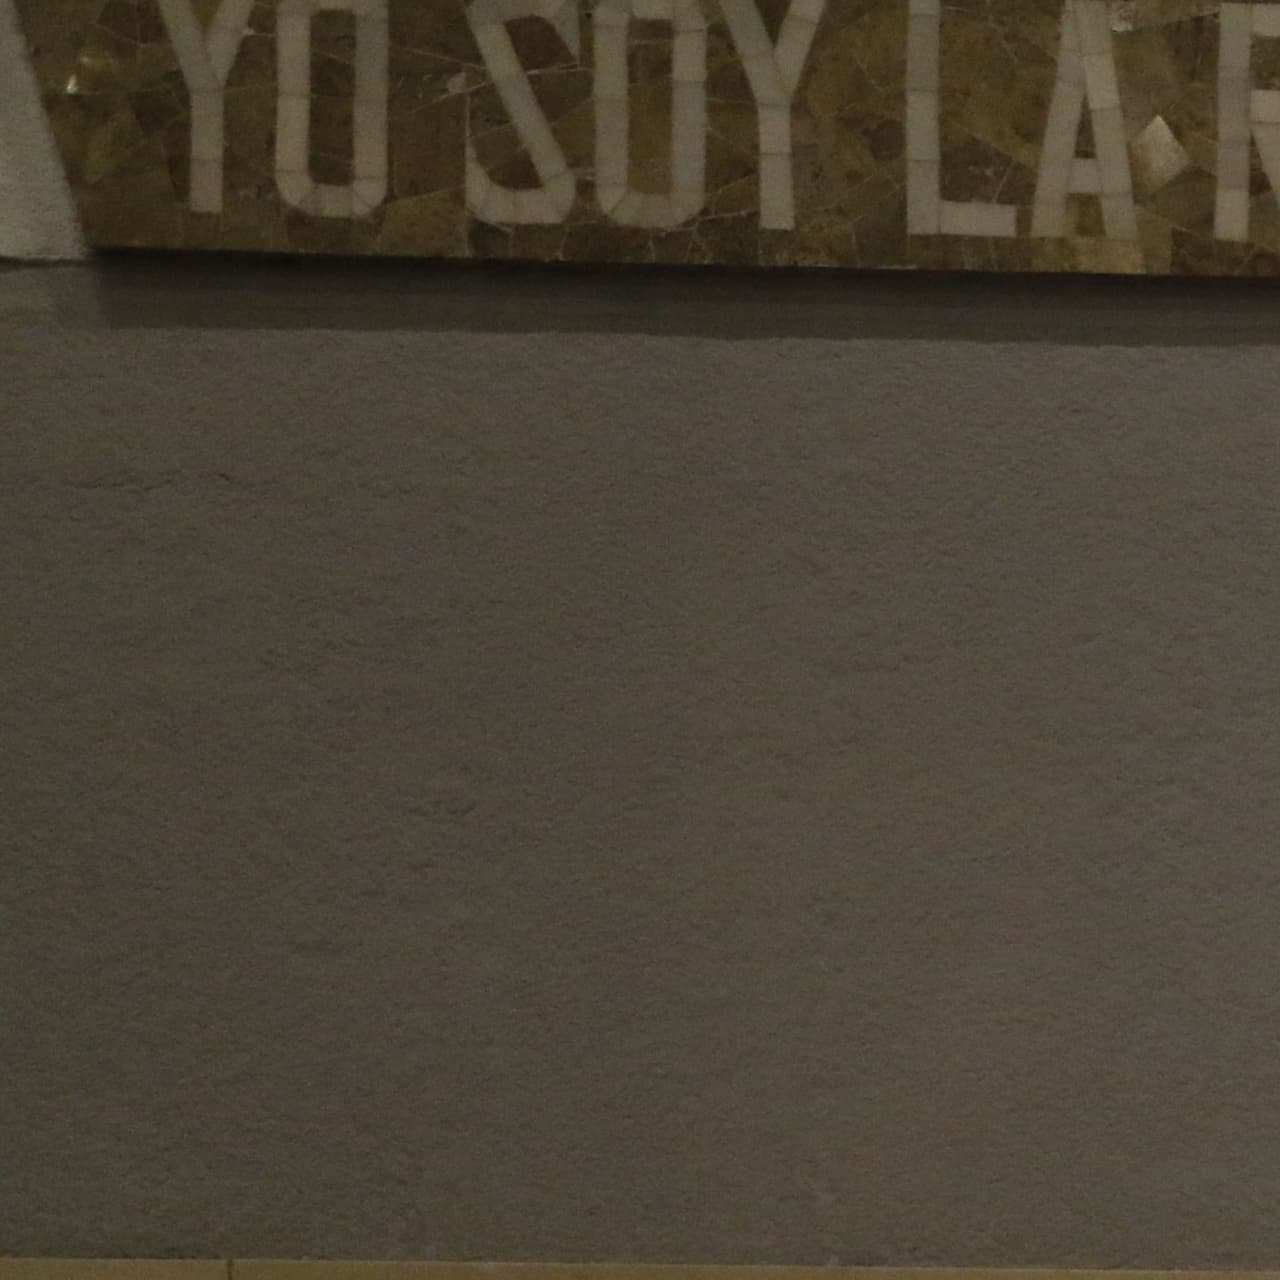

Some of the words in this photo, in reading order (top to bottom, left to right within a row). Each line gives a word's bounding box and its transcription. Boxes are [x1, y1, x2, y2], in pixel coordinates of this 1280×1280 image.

[157, 0, 388, 219] YO
[464, 0, 843, 231] SOY
[906, 0, 1138, 240] LA
